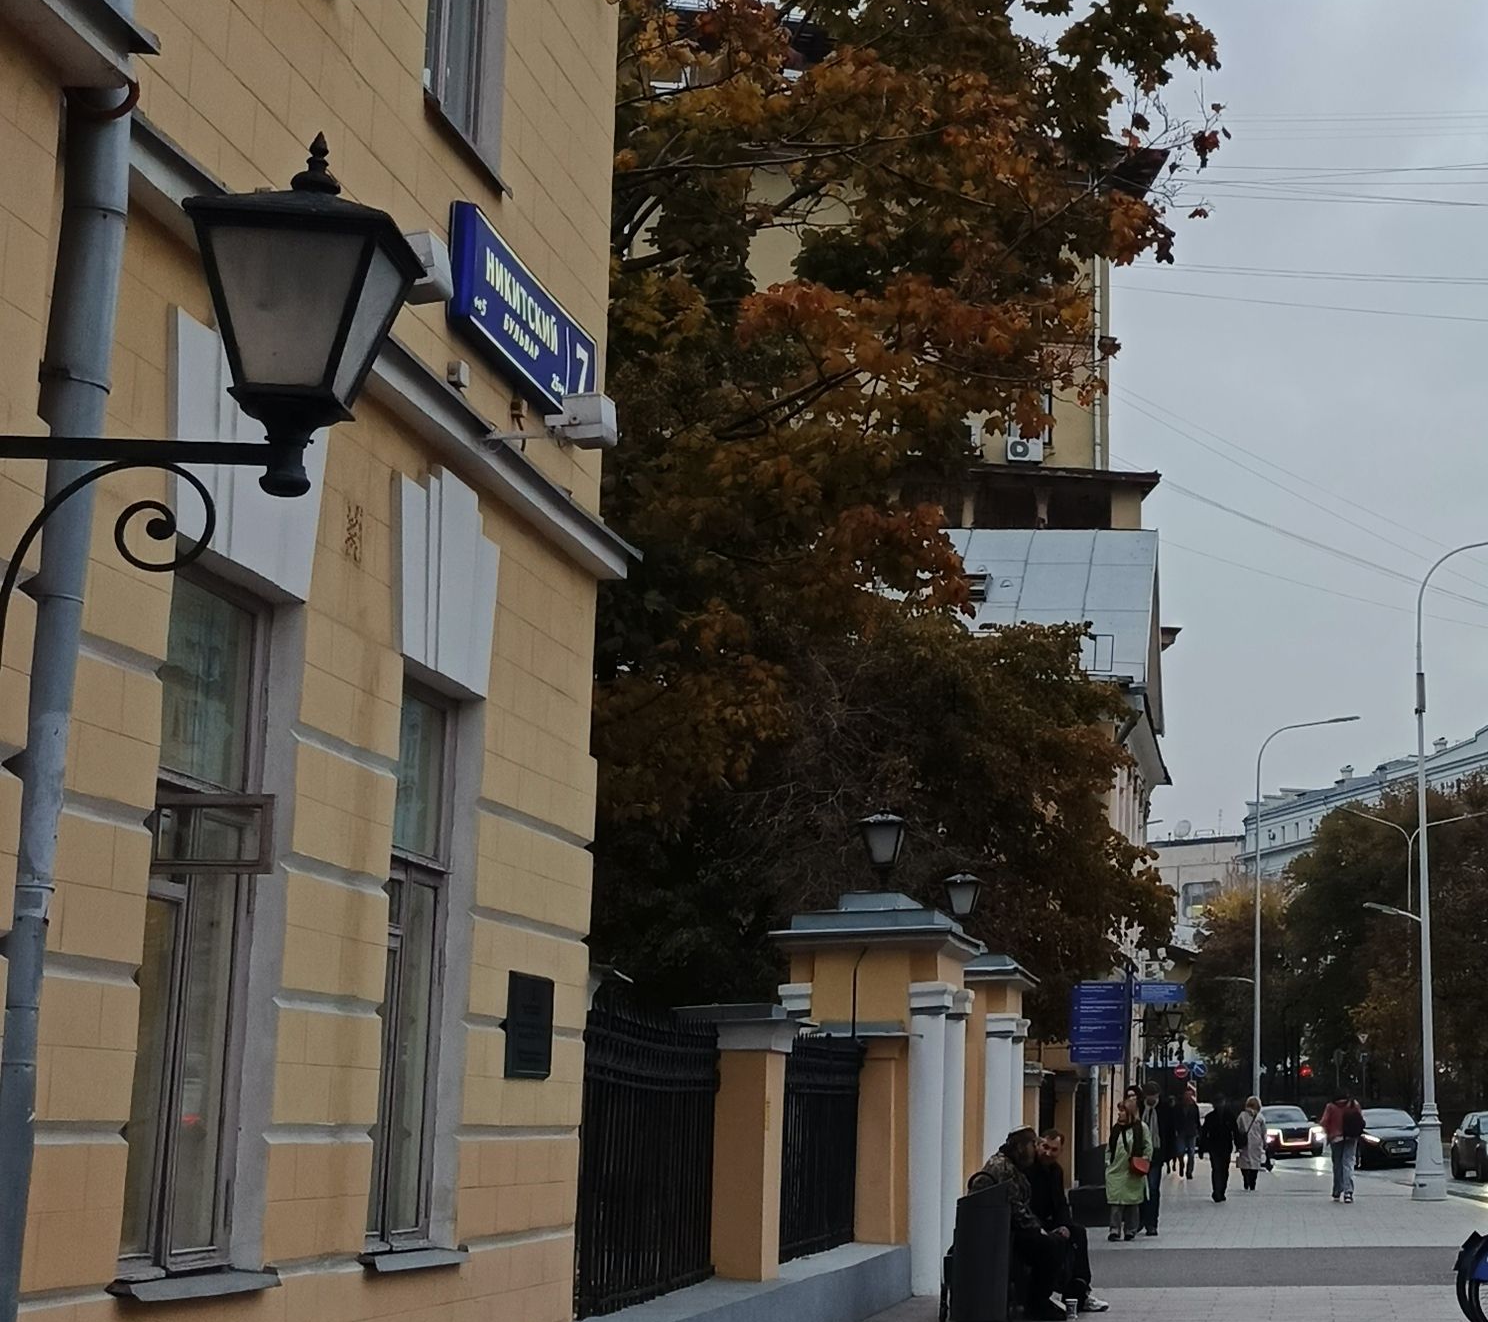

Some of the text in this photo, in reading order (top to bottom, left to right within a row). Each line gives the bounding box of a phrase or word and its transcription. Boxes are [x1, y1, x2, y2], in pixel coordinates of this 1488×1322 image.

[485, 246, 559, 356] НИКИТСКИЙ
[503, 312, 540, 361] БУЛЬВАР
[575, 342, 589, 394] 7
